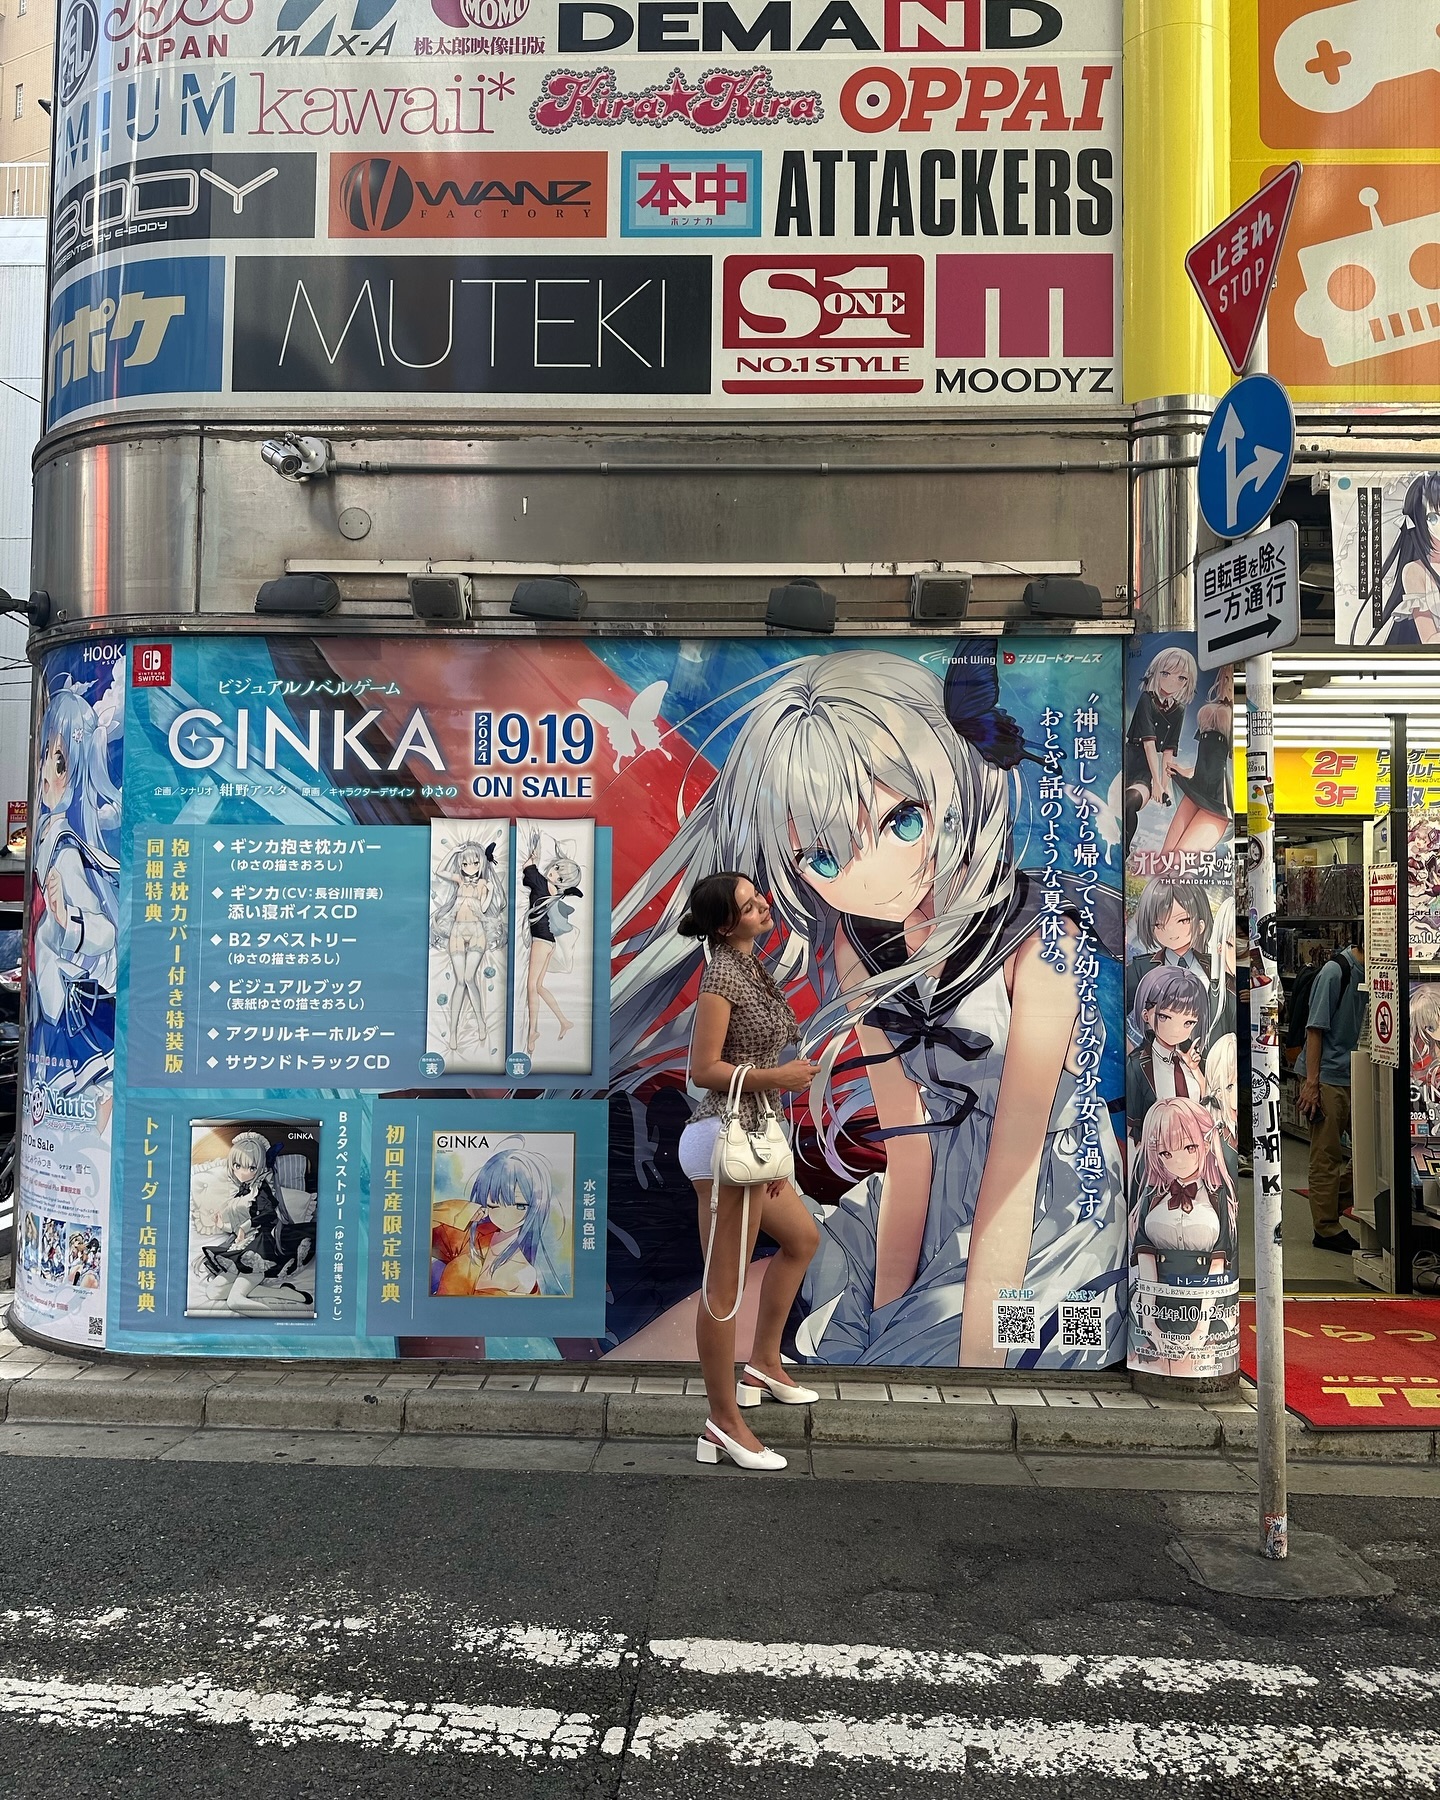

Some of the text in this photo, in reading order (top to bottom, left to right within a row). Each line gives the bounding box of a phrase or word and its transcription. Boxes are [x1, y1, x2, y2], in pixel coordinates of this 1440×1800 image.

[558, 0, 1063, 51] DEMAND
[117, 34, 228, 71] JAPAN
[413, 36, 546, 56] 桃太郎映像出版
[839, 66, 1114, 133] OPPAI
[57, 72, 237, 178] MIUM
[415, 181, 592, 206] WANZ
[637, 163, 747, 215] 本中
[774, 148, 1114, 237] ATTACKERS
[420, 208, 592, 219] FACTORY
[670, 217, 713, 226] ホンナカ
[114, 221, 168, 238] E-BODY
[1207, 210, 1274, 287] 止まれ
[1218, 257, 1265, 314] STOP
[822, 292, 905, 315] ONE
[278, 279, 666, 368] MUTEKI
[935, 367, 1114, 393] MOODYZ
[1359, 493, 1368, 594] 会いたい人がいるからだよ
[1373, 493, 1382, 623] 私がニライカナイに行きたいのは、
[1204, 542, 1287, 598] 自転車を除く
[1204, 572, 1287, 624] 一方通行
[83, 643, 125, 663] HOOK
[941, 654, 996, 666] Front Wing
[218, 678, 401, 696] ビジュアルノベルゲーム
[168, 707, 446, 771] GINKA
[478, 711, 595, 765] 2024 9.19
[1311, 750, 1357, 776] 2F
[219, 783, 288, 798] 紺野アスタ
[421, 786, 458, 798] ゆさの
[472, 776, 593, 797] ON SALE
[1314, 781, 1358, 807] 3F
[230, 838, 382, 855] ギンカ抱き枕カバー
[1038, 706, 1066, 973] おとぎ話のような夏休み。
[230, 859, 344, 872] (ゆさの描きおろし)
[145, 838, 165, 923] 同梱特典
[1179, 878, 1215, 886] MAIDEN'S
[228, 904, 358, 921] 添い寝ボイスCD
[228, 932, 357, 948] B2 タペストリー
[164, 838, 190, 1074] 抱き枕カバー付き特装版
[228, 953, 341, 966] (ゆさの描きおろし)
[228, 979, 362, 995] ビジュアルブック
[226, 997, 365, 1011] (表紙ゆさの描きおろし)
[226, 1025, 396, 1042] アクリルキーホルダー
[225, 1054, 391, 1070] サウンドトラックCD
[425, 1062, 438, 1075] 表
[512, 1062, 525, 1075] 裏
[46, 1089, 97, 1119] Nauts
[27, 1135, 36, 1147] On
[37, 1137, 55, 1152] Sale
[287, 1132, 314, 1140] GINKA
[436, 1135, 490, 1149] GINKA
[137, 1117, 159, 1313] トレーダー店舗特典
[380, 1124, 405, 1303] 初回生産限定特典
[582, 1178, 597, 1250] 水彩風色紙
[1176, 1274, 1230, 1286] トレーダー特典
[1160, 1332, 1191, 1341] mignon
